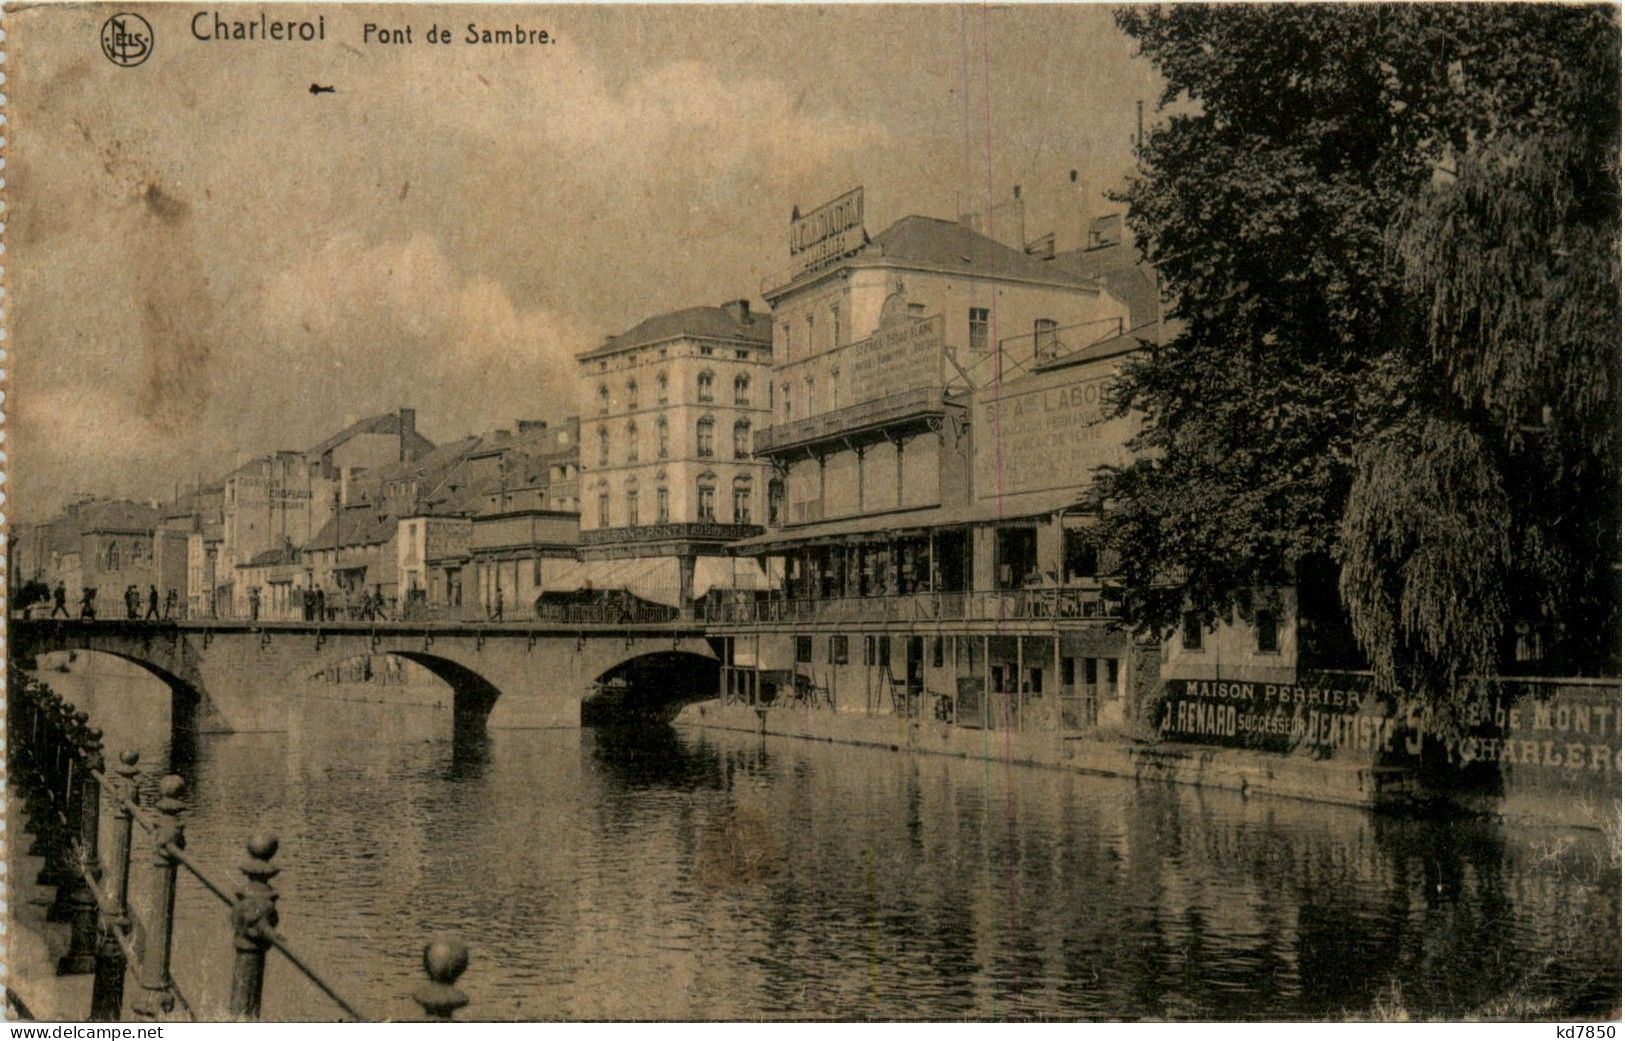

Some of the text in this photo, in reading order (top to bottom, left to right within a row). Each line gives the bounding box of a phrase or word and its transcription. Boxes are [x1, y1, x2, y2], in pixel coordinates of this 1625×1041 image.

[1186, 681, 1362, 707] MAISON PERRIER
[1239, 713, 1305, 737] SUCCESSEUR
[1309, 710, 1394, 751] DENTISTE
